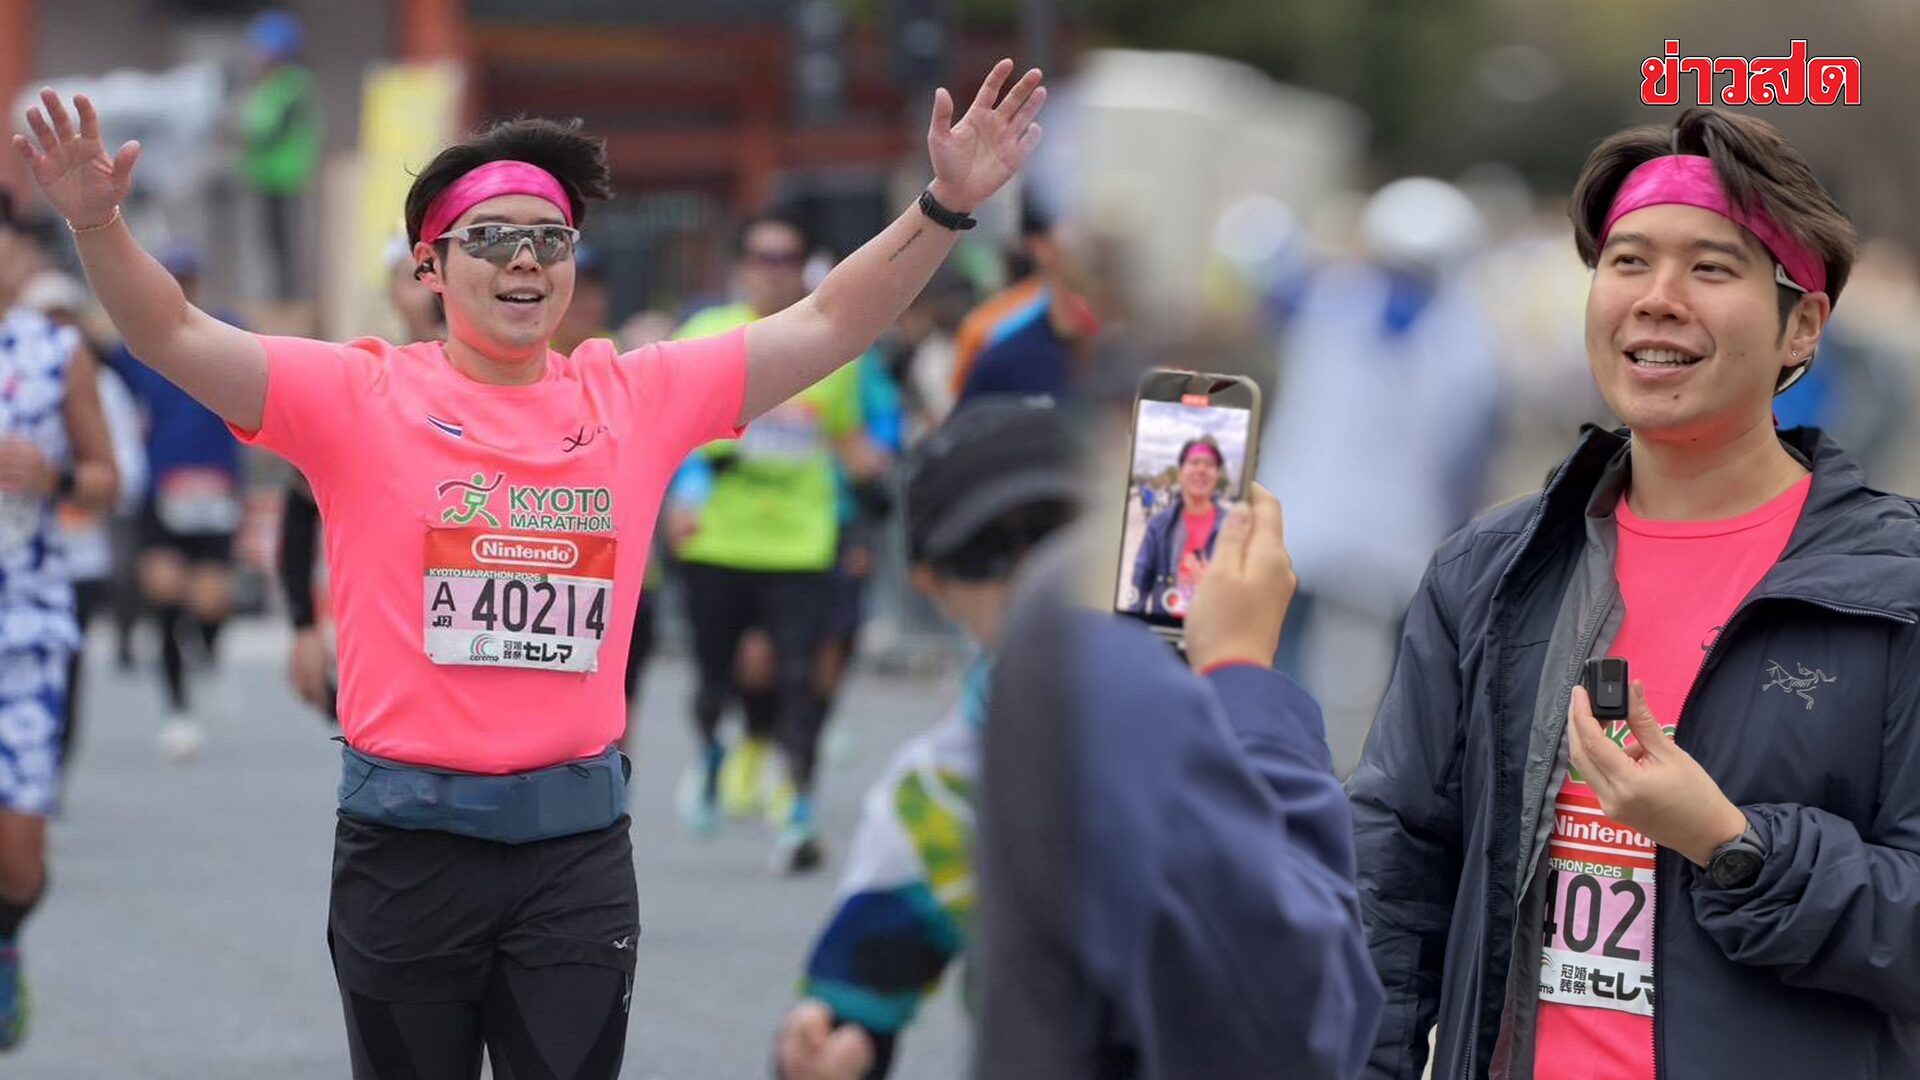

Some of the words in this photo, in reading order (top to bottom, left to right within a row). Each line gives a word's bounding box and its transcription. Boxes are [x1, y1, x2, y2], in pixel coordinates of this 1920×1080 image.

[509, 486, 612, 514] KYOTO
[510, 513, 612, 531] MARATHON
[482, 540, 570, 562] Nintendo
[429, 568, 460, 577] KYOTO
[461, 569, 514, 580] MARATHON
[431, 581, 456, 611] A
[472, 579, 605, 640] 40214
[523, 642, 573, 663] セレマ
[1553, 814, 1657, 848] Nintend
[1584, 862, 1622, 878] 2026
